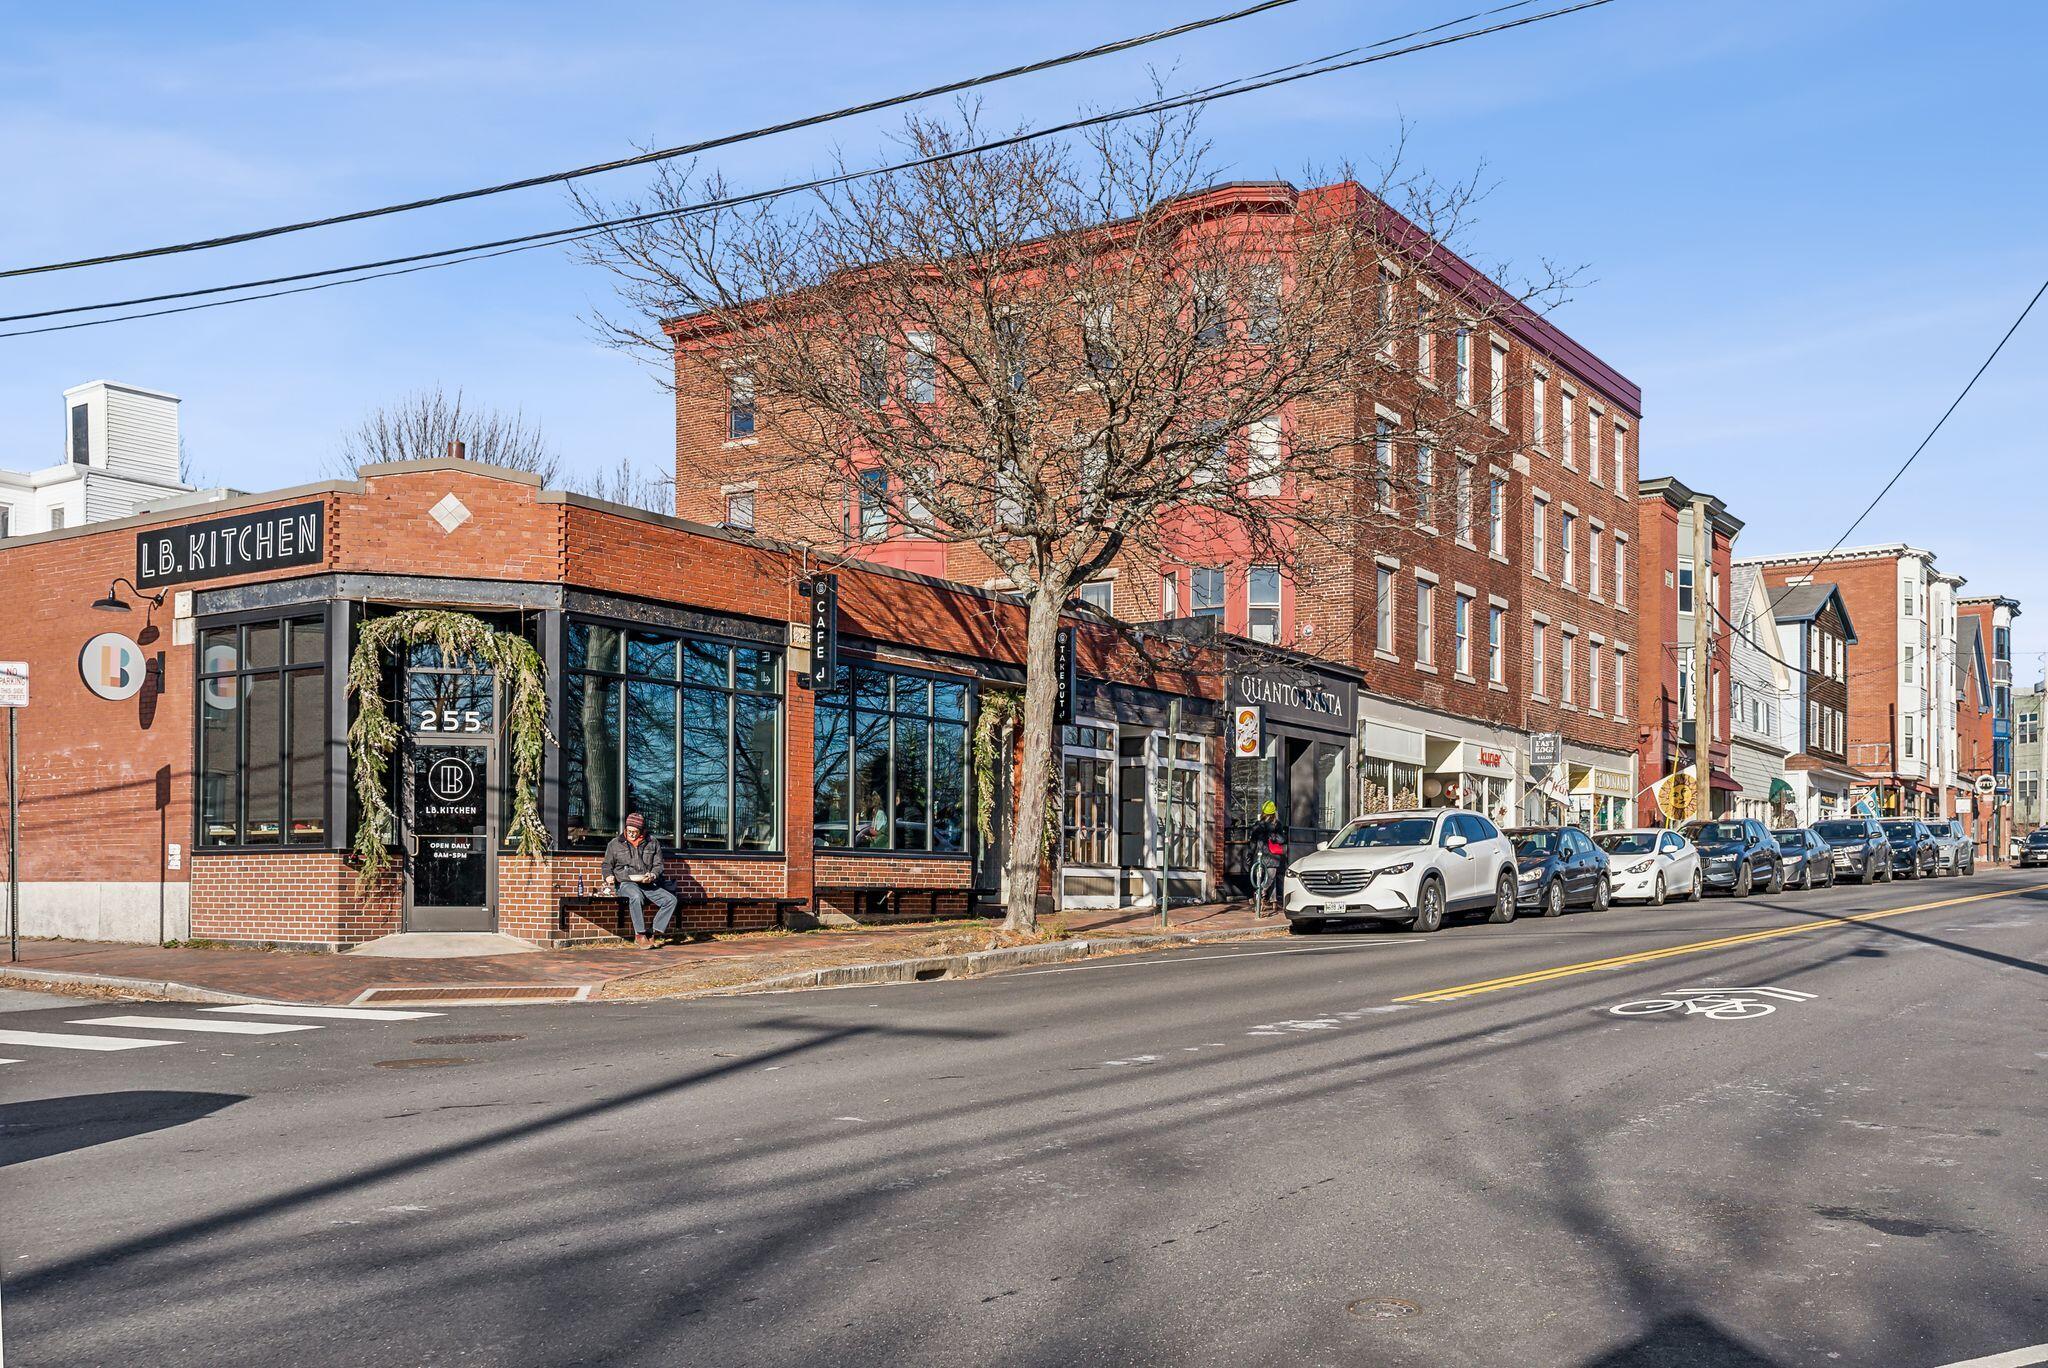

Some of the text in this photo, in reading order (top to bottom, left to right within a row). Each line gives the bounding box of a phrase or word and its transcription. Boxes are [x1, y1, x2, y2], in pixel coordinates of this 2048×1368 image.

[816, 601, 826, 659] CAFE
[7, 668, 17, 676] NO
[1241, 676, 1343, 716] QUANTO BASTA
[420, 710, 481, 732] 255
